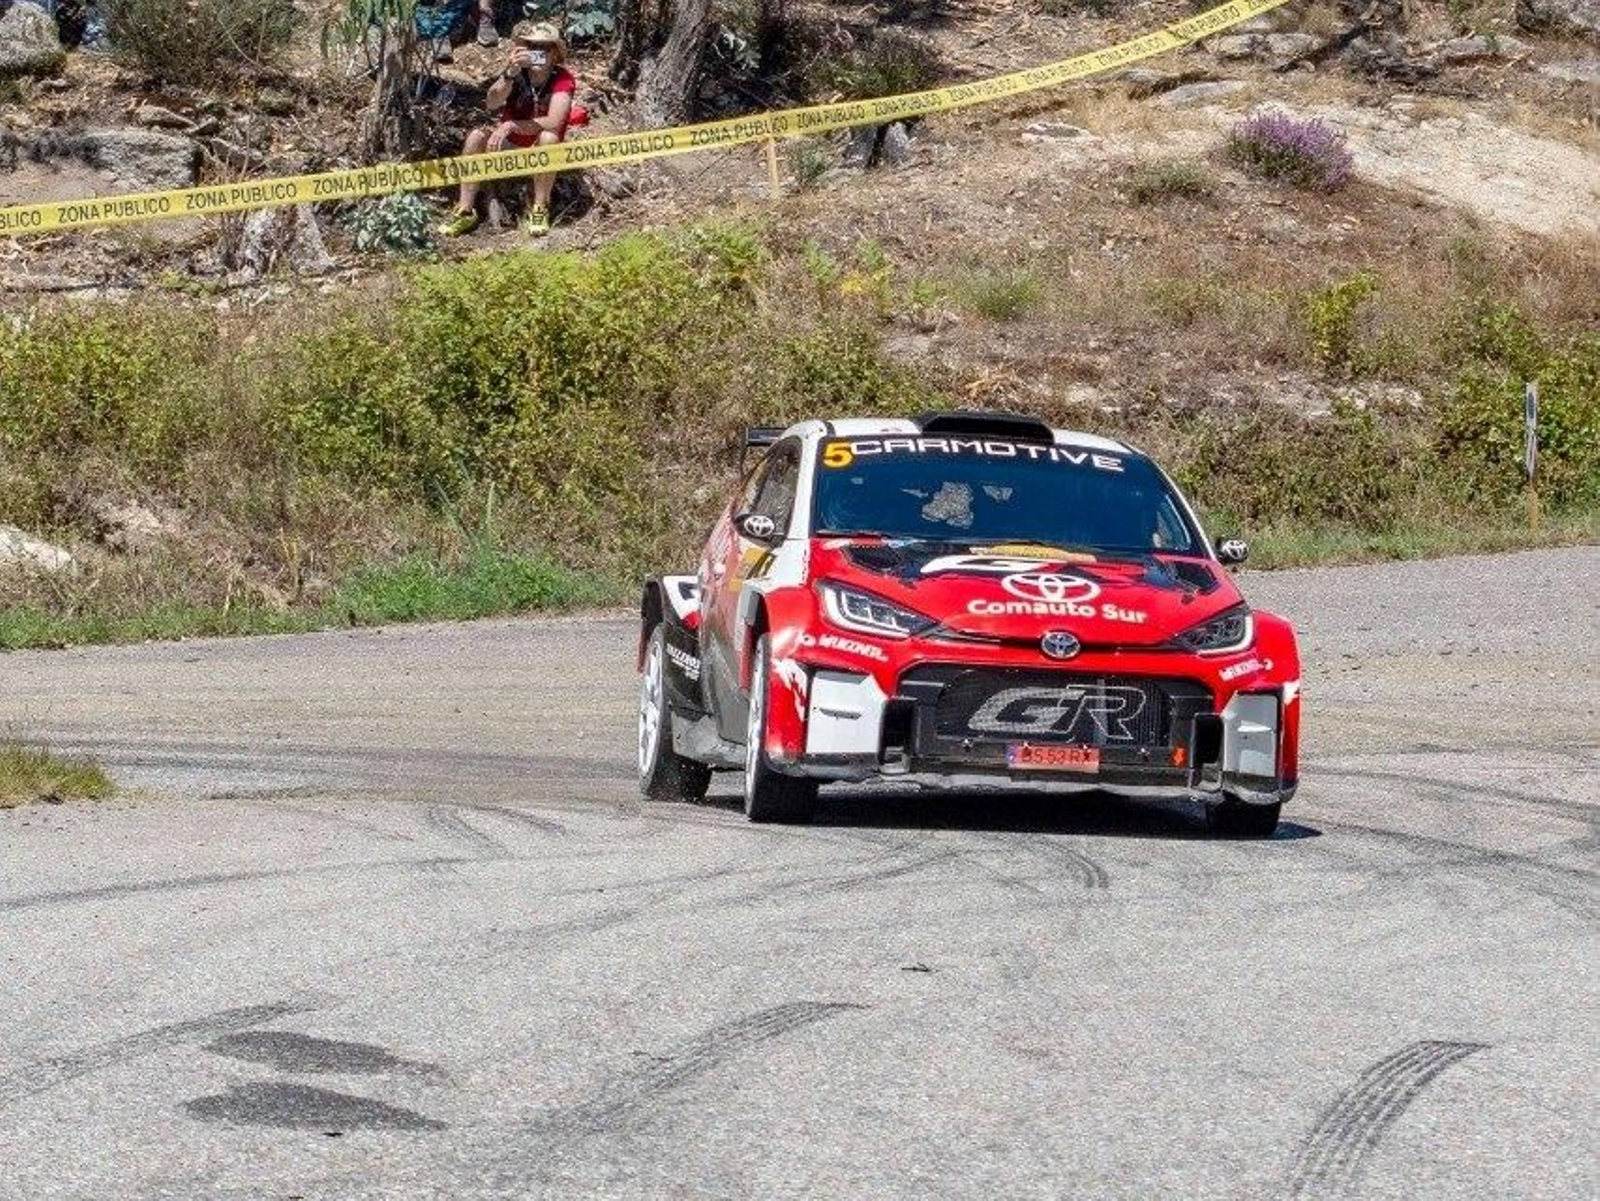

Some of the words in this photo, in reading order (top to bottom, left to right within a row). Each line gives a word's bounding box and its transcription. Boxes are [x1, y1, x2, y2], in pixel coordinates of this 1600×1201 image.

[1200, 5, 1240, 31] PUBLICO
[690, 127, 731, 145] ZONA
[734, 116, 788, 137] PUBLICO
[797, 111, 823, 129] ZONA
[824, 105, 865, 124] PUBLICO
[565, 143, 604, 163] ZONA
[610, 135, 674, 156] PUBLICO
[440, 160, 480, 180] ZONA
[484, 151, 550, 173] PUBLICO
[313, 177, 354, 196] ZONA
[358, 168, 424, 190] PUBLICO
[58, 204, 100, 223] ZONA
[104, 197, 170, 218] PUBLICO
[186, 192, 227, 210] ZONA
[231, 183, 297, 204] PUBLICO
[823, 440, 853, 469] 5
[851, 438, 1125, 472] CARMOTIVE
[967, 599, 1096, 618] Comauto
[1103, 603, 1148, 624] Sur
[968, 684, 1146, 740] GR
